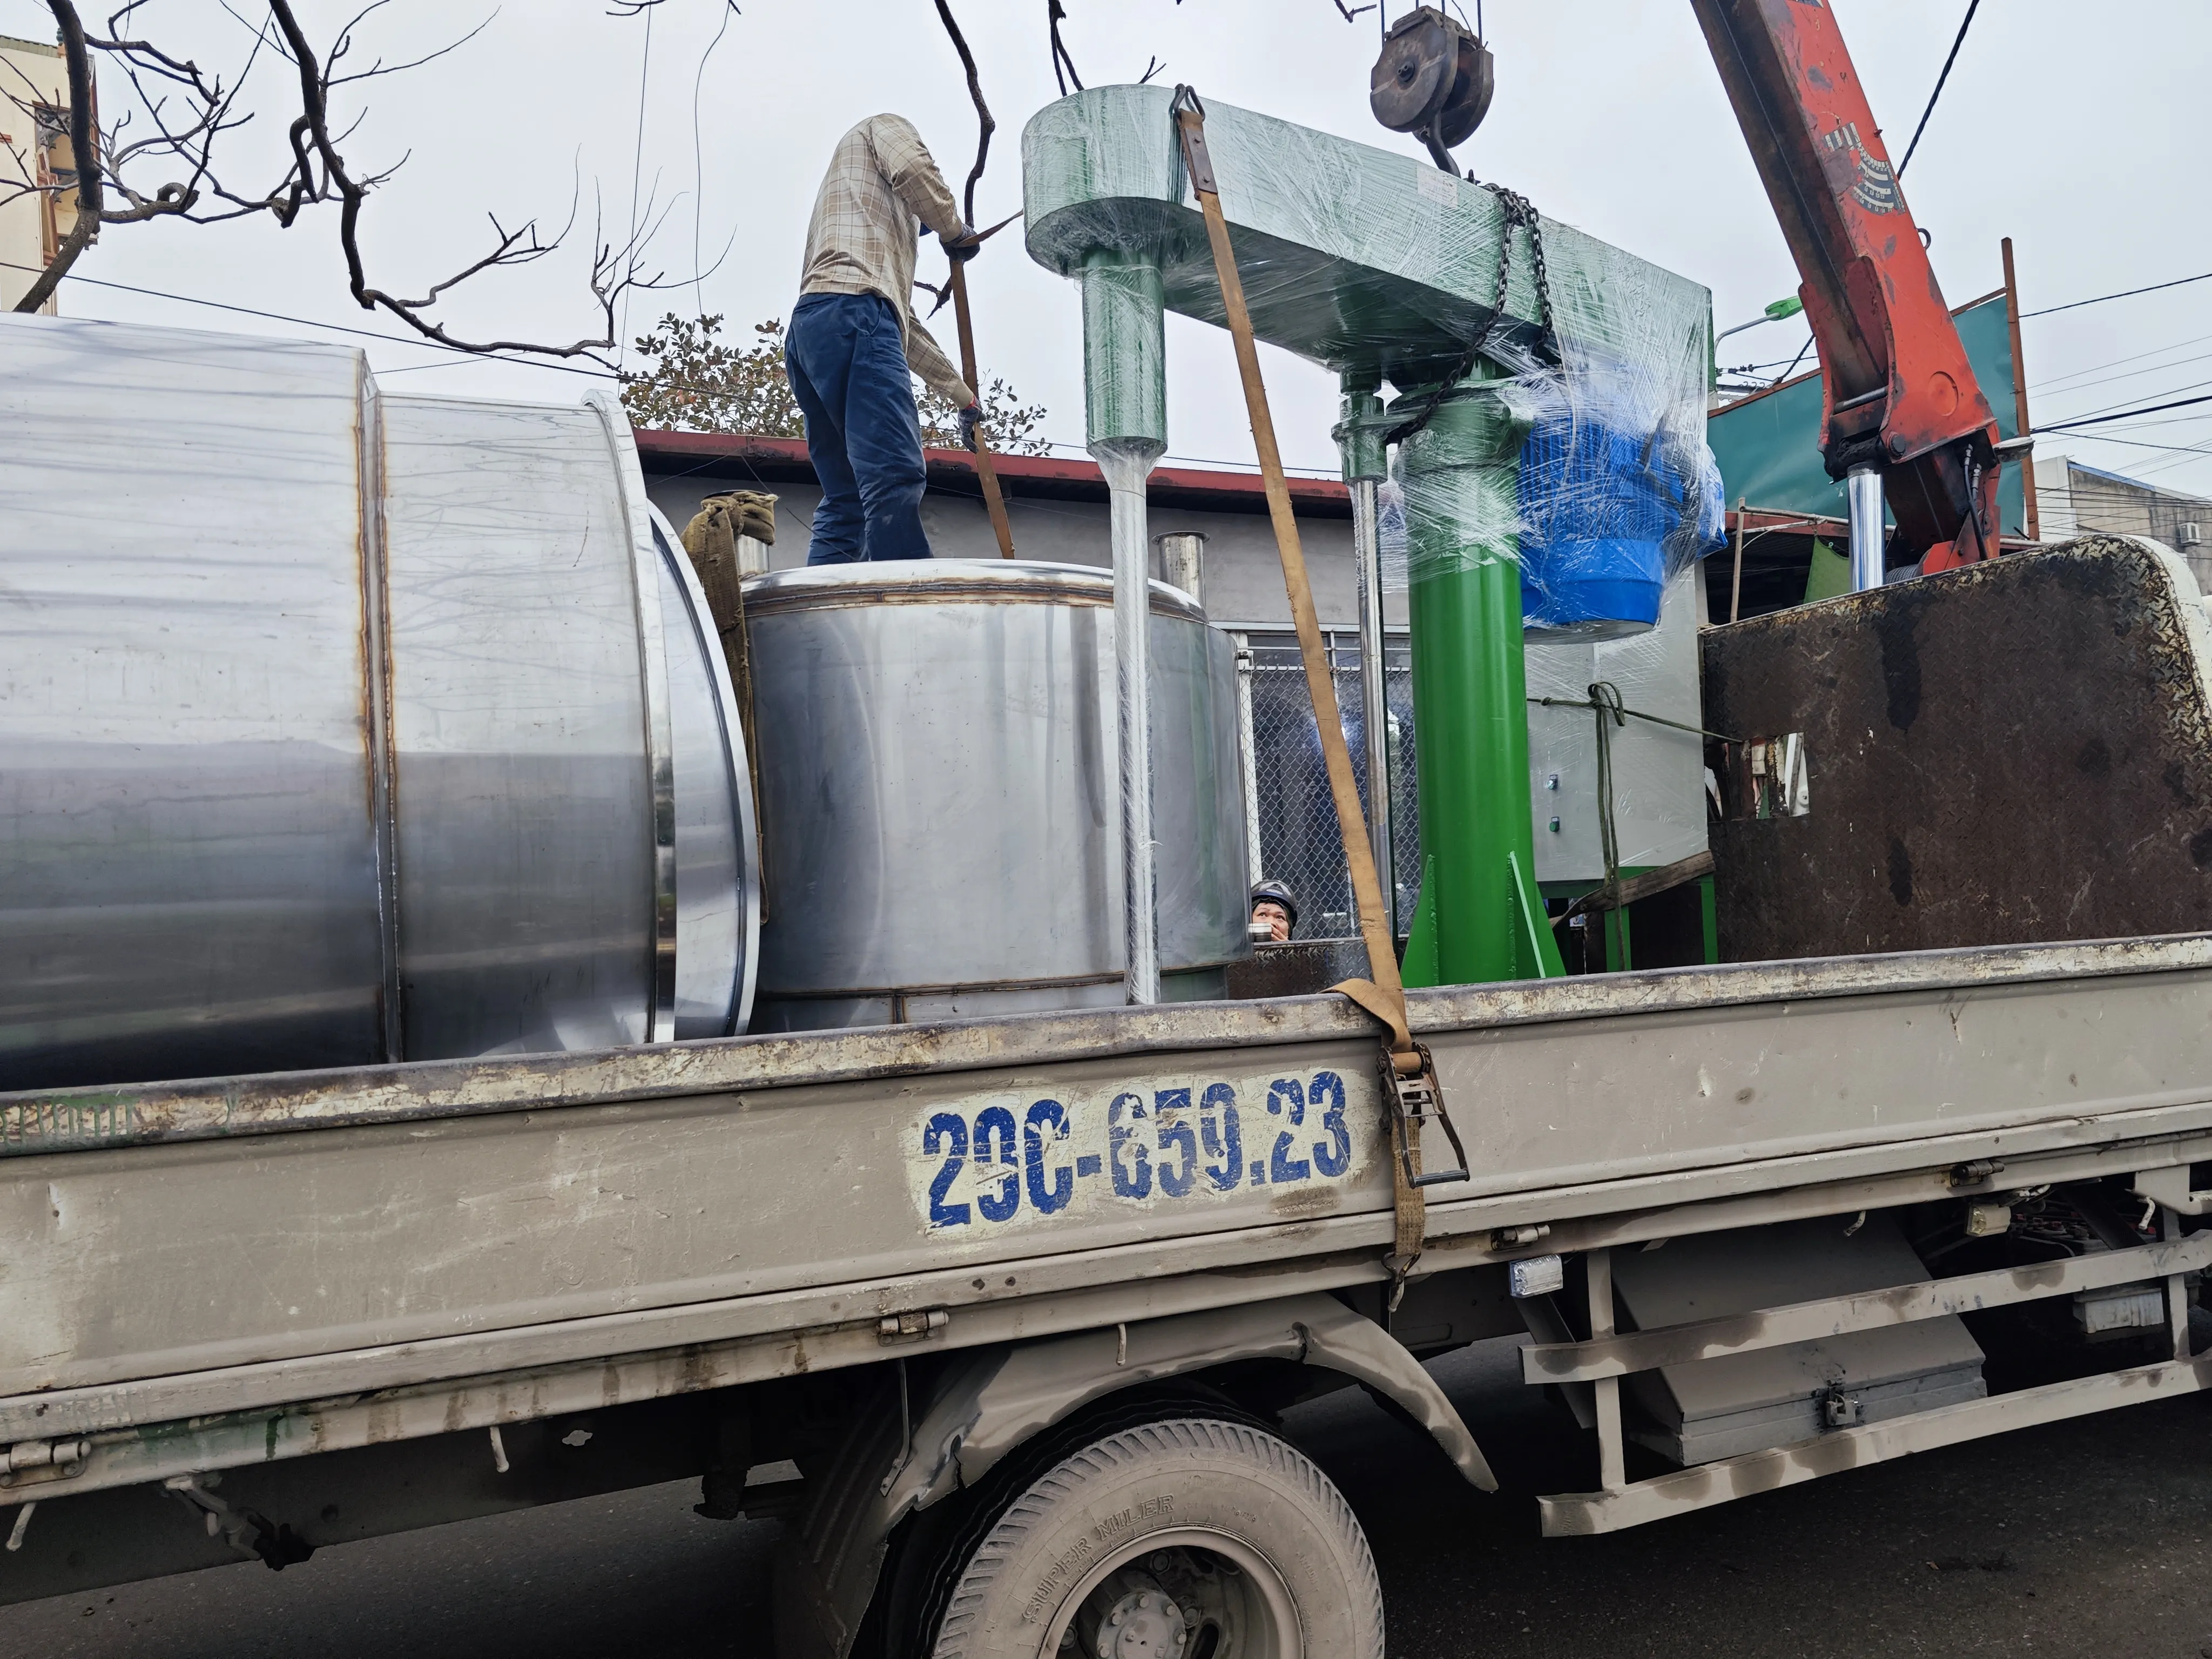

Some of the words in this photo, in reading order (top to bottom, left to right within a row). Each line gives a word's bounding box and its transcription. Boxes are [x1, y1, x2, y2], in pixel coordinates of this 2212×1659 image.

[923, 1071, 1351, 1229] 29C-659.23
[1022, 1537, 1092, 1623] SUPER
[1095, 1493, 1175, 1540] MILER
